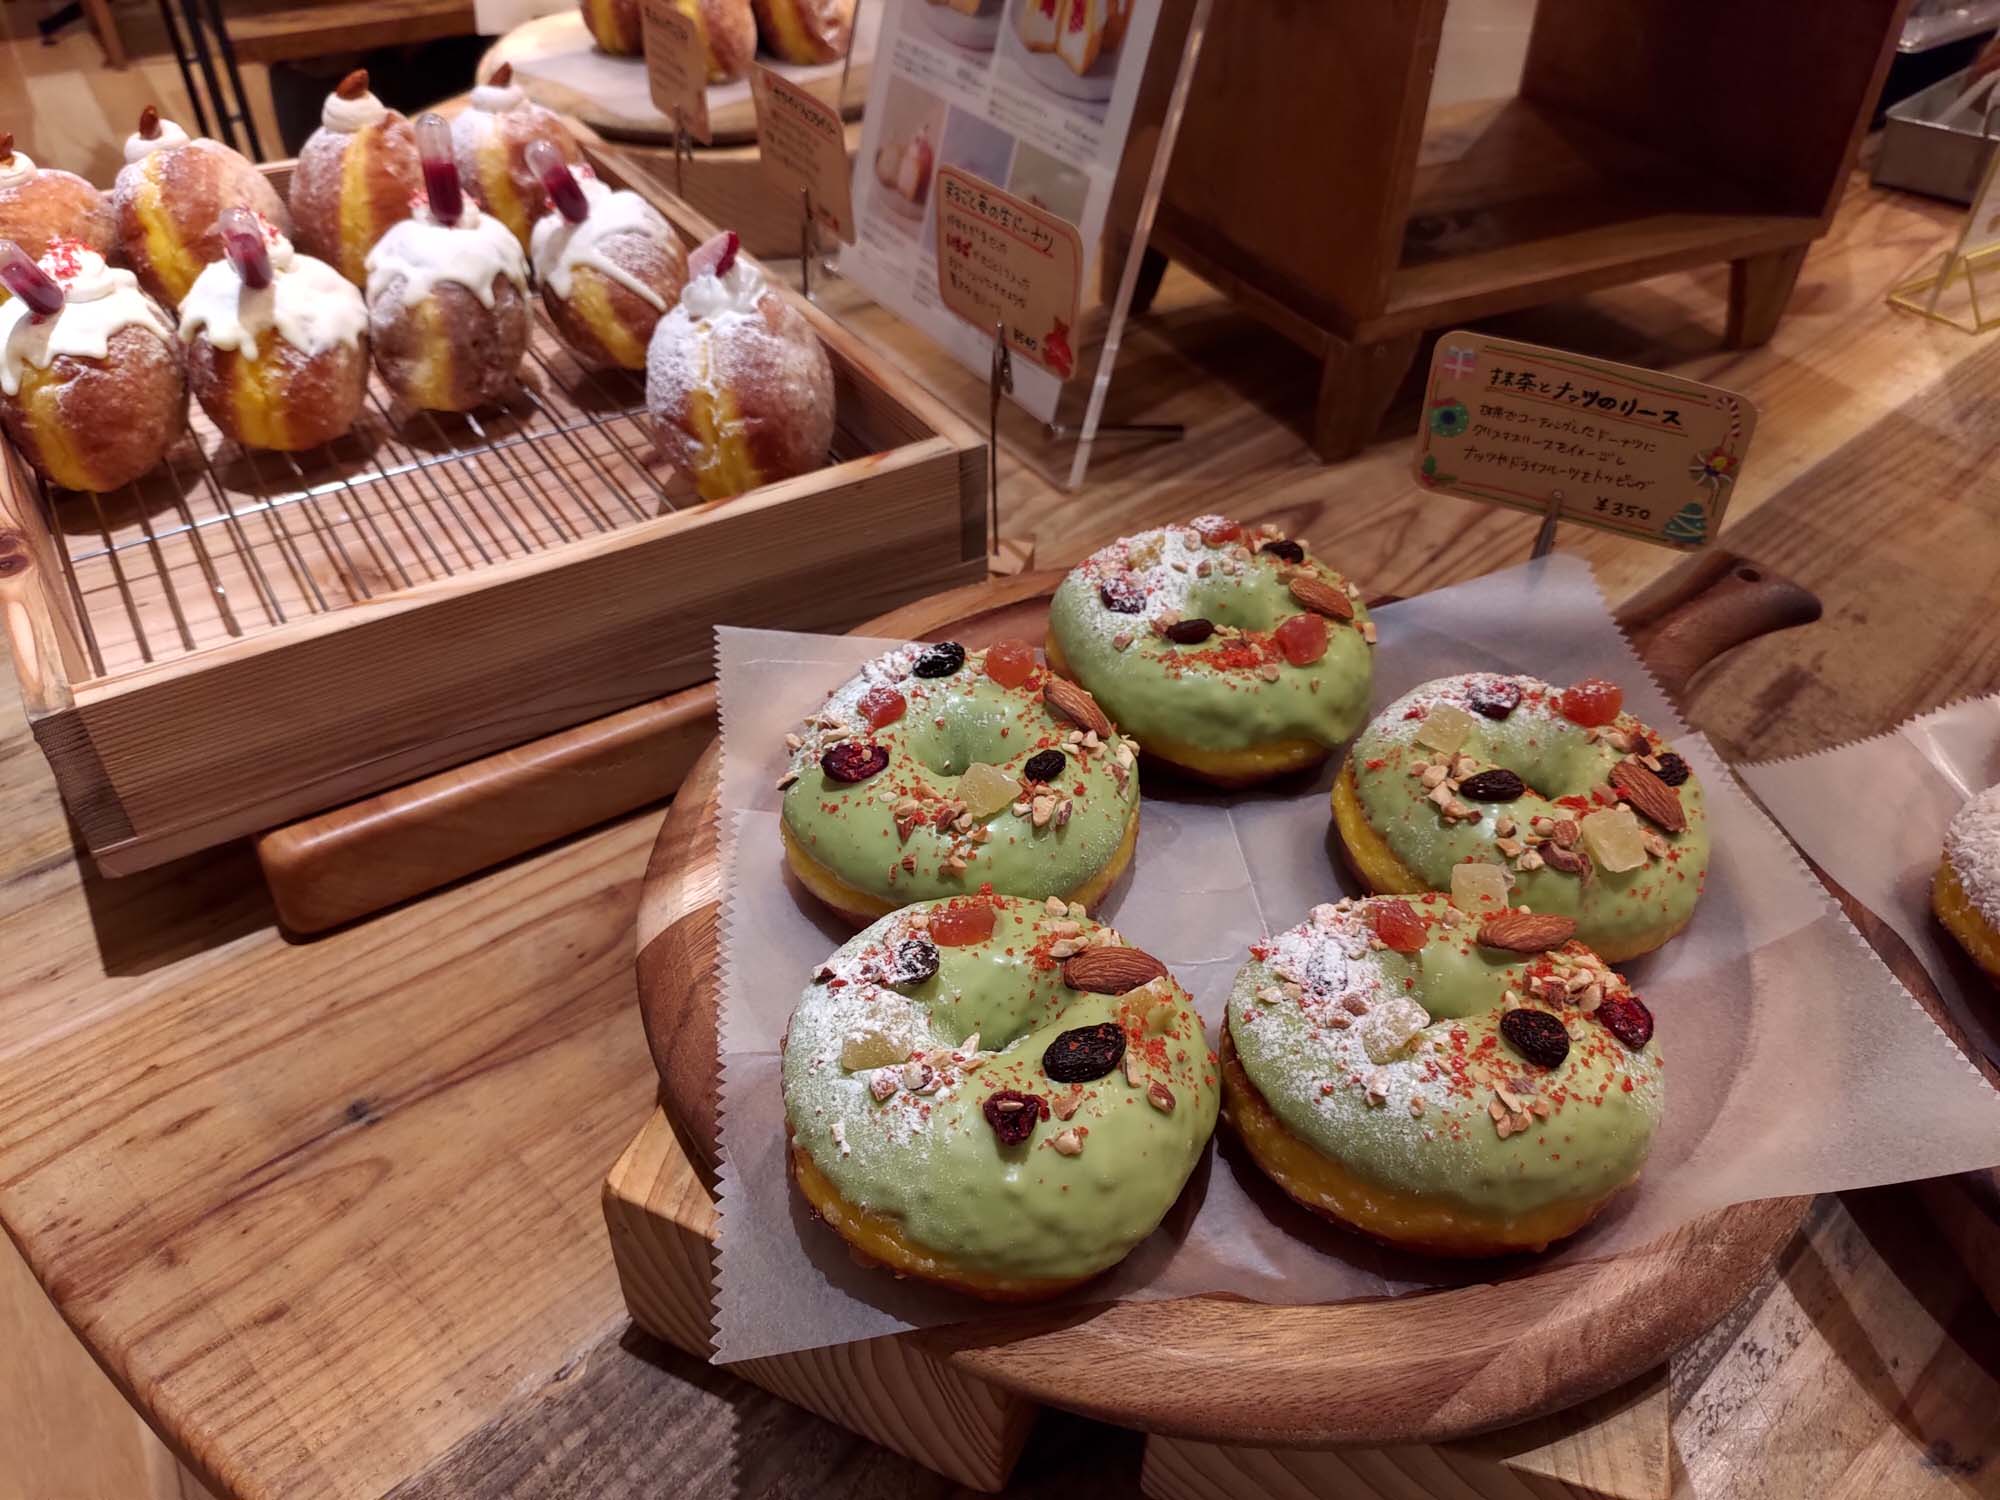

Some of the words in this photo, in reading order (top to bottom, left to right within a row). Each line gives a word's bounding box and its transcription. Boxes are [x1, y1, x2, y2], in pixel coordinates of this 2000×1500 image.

[1489, 367, 1682, 426] 抹茶とナッツのリース
[1593, 496, 1651, 521] ¥350
